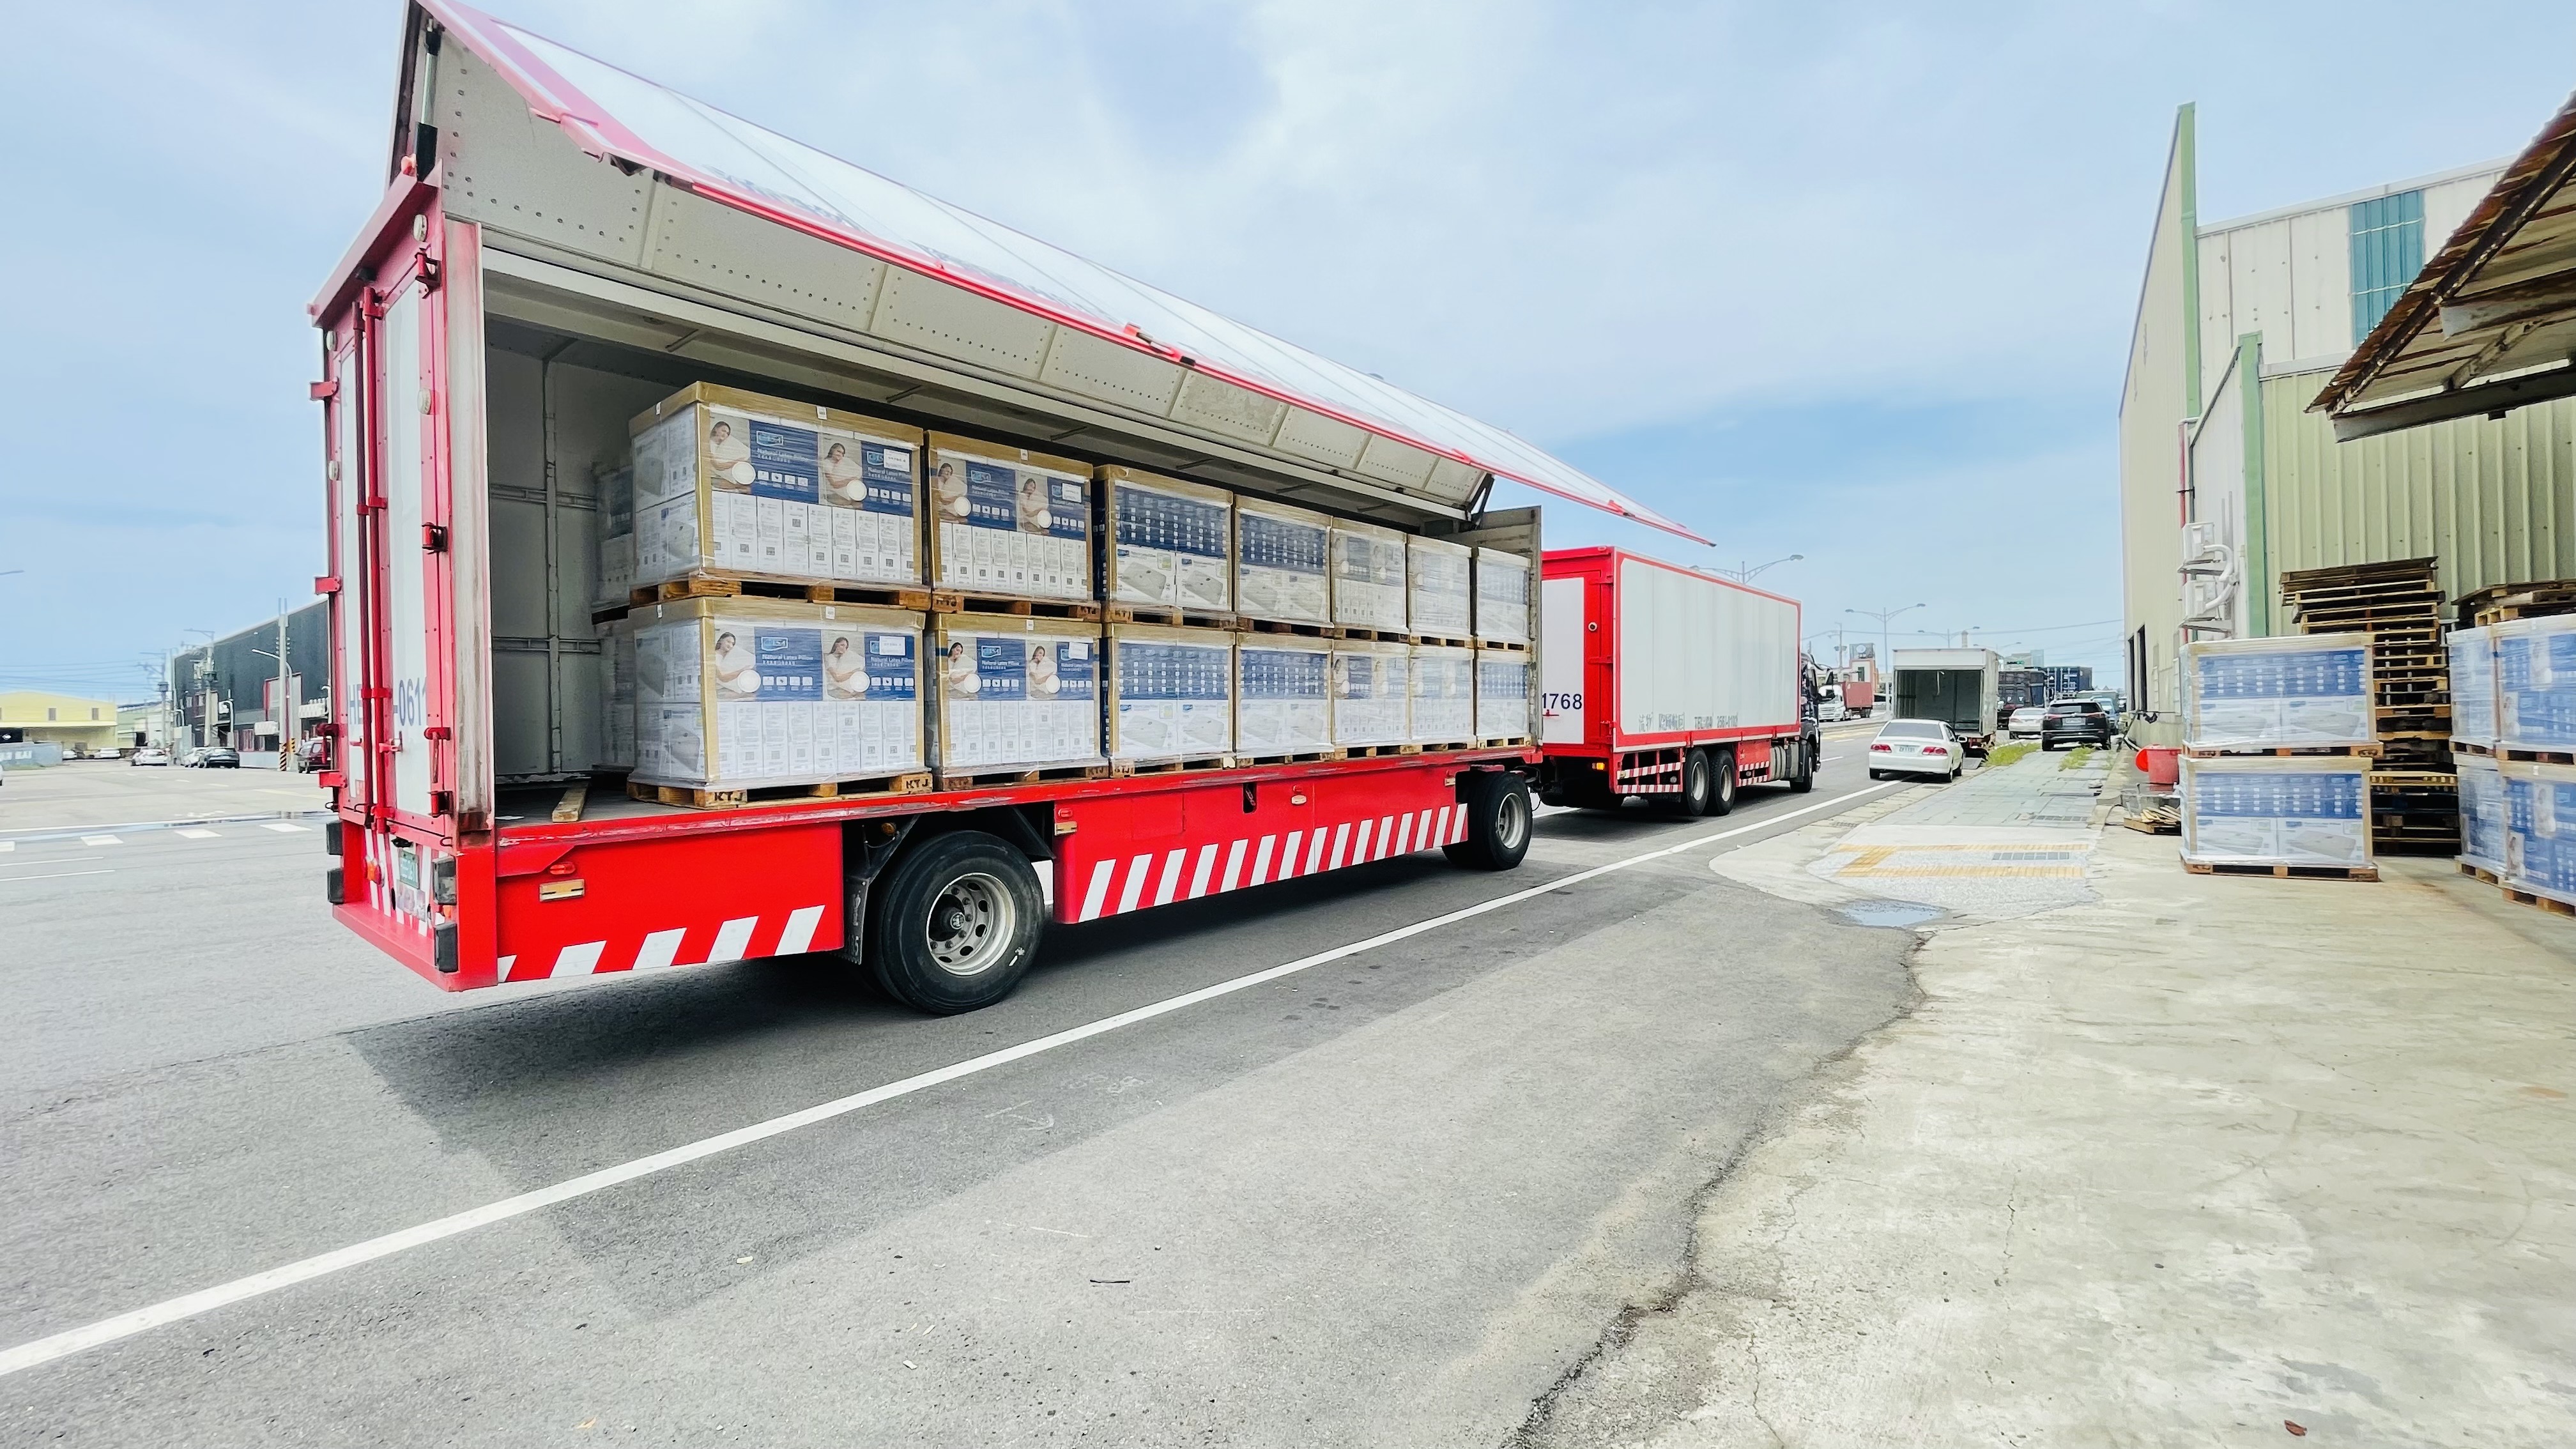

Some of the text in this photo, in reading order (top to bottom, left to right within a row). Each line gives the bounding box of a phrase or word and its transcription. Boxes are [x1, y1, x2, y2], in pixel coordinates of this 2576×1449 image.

[1542, 693, 1583, 710] 1768
[906, 778, 929, 789] KTJ
[714, 791, 743, 802] KTJ
